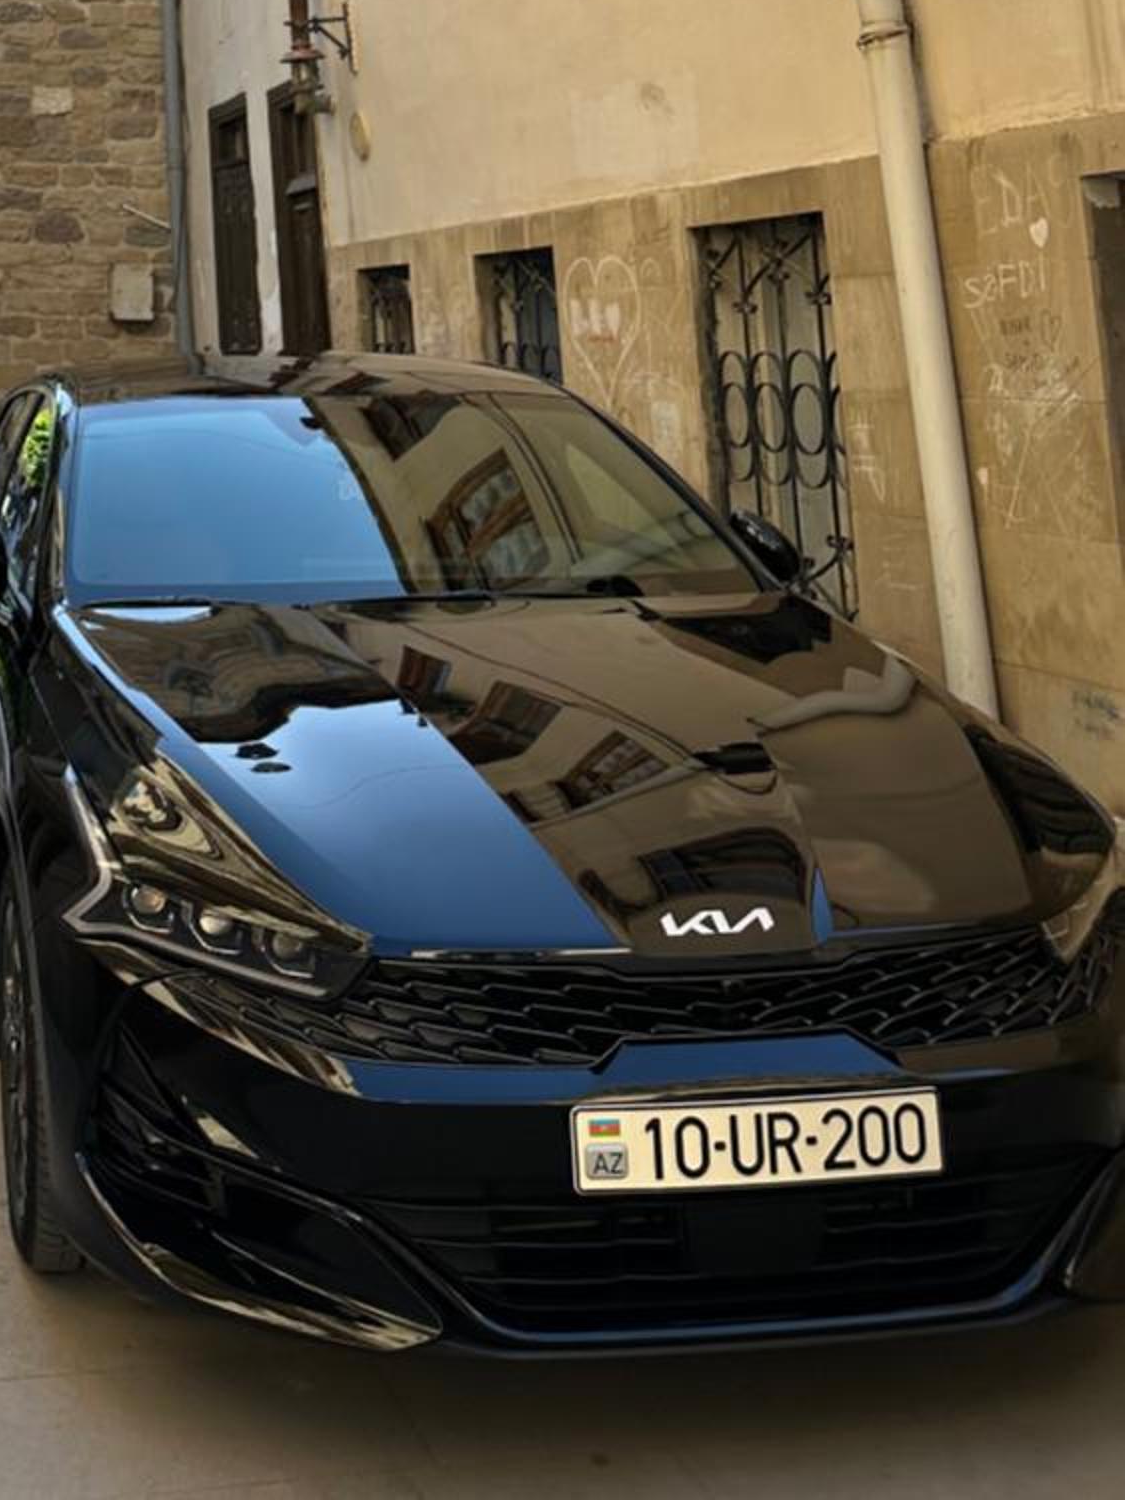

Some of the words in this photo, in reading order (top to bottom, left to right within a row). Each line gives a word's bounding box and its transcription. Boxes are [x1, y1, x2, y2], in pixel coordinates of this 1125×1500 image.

[660, 907, 775, 936] KIA
[644, 1102, 927, 1181] 10-UR-200
[593, 1151, 624, 1175] AZ
